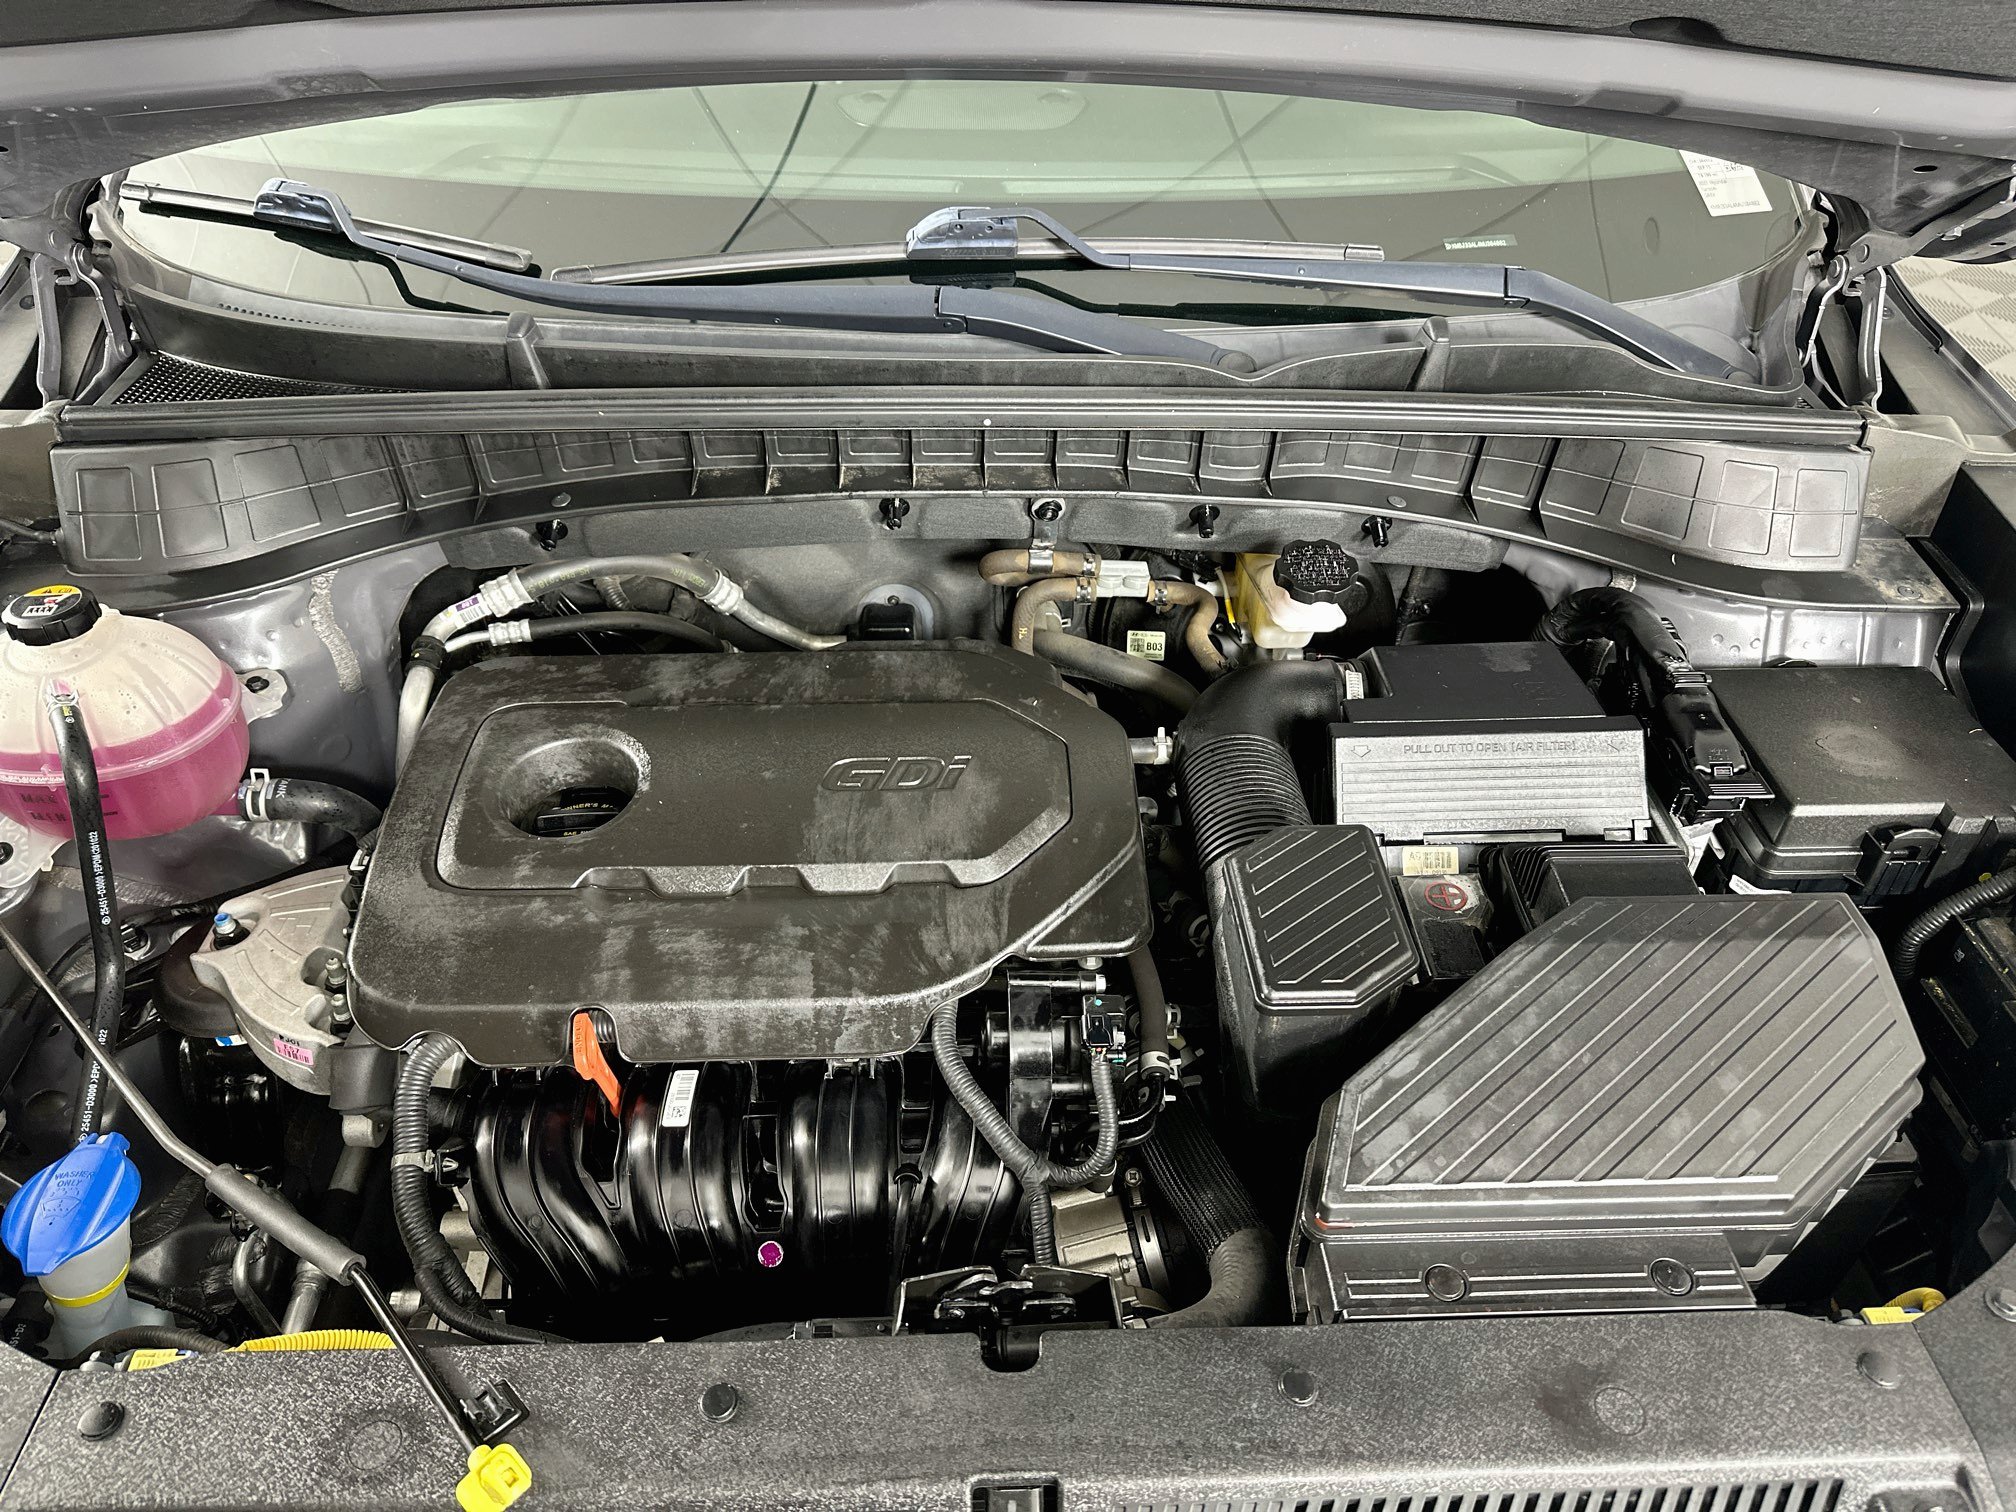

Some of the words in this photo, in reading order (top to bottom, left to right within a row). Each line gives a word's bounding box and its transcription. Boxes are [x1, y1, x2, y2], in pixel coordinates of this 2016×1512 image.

[1146, 642, 1163, 652] B03
[1403, 744, 1432, 754] PULL
[1434, 743, 1456, 753] OUT
[1458, 743, 1473, 753] TO
[1474, 742, 1507, 752] OPEN
[821, 755, 972, 791] GDi
[80, 1083, 98, 1132] 25451-D3000
[55, 1170, 95, 1180] WASHER
[57, 1179, 82, 1188] ONLY
